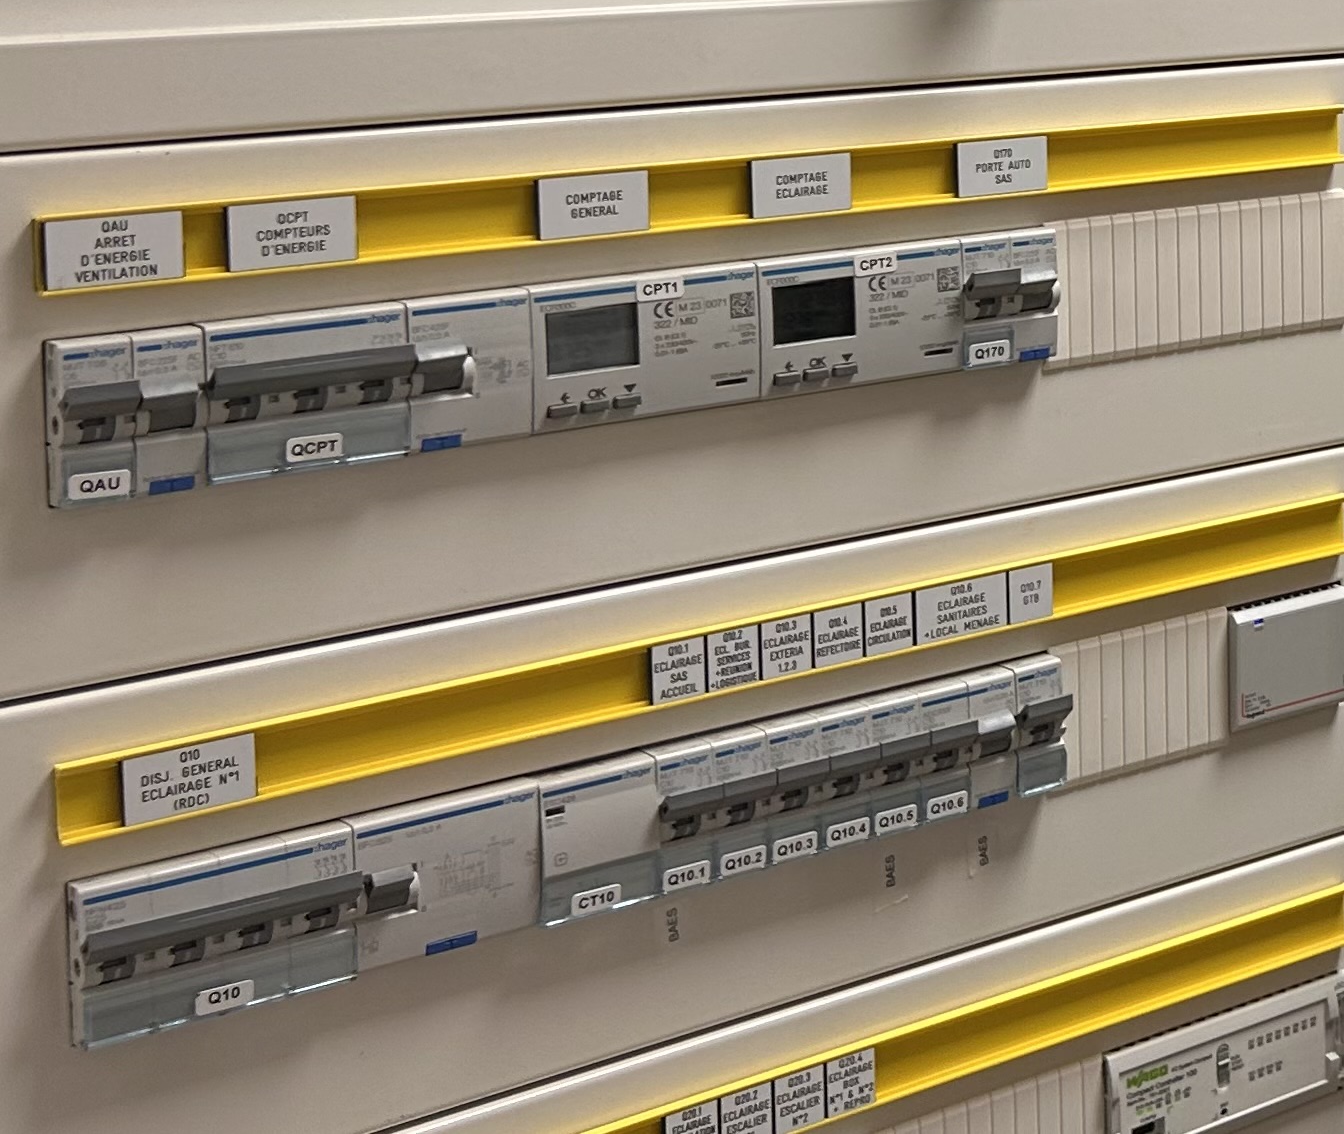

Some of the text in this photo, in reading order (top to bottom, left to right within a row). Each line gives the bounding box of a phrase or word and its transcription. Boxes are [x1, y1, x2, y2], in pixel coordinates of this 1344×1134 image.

[975, 159, 1031, 173] PORTE AUTO
[775, 171, 828, 186] COMPTAGE
[995, 173, 1013, 184] SAS
[565, 190, 623, 206] COMPTAGE
[775, 184, 829, 200] ECLAIRAGE
[570, 204, 619, 219] GENERAL
[101, 219, 129, 233] QAU
[255, 224, 331, 242] COMPTEURS
[94, 234, 137, 250] ARRET
[260, 240, 327, 257] D'ENERGIE
[80, 249, 151, 267] D'ENERGIE
[859, 256, 893, 272] CPT2
[74, 264, 159, 283] VENTILATION
[642, 282, 678, 296] CPT1
[689, 301, 702, 311] 23
[654, 319, 672, 330] 322
[974, 345, 1005, 360] Q170
[587, 386, 607, 400] OK
[290, 439, 338, 456] QCPT
[80, 477, 120, 493] QAU
[950, 582, 973, 596] Q10.6
[937, 592, 986, 612] ECLAIRAGE
[936, 604, 988, 625] SANITAIRES
[963, 614, 1000, 631] MENAGE
[775, 620, 797, 634] Q10.3
[869, 615, 908, 633] ECLAIRAGE
[763, 630, 810, 650] ECLAIRAGE
[817, 626, 860, 645] ECLAIRAGE
[867, 627, 912, 647] CIRCULATION
[667, 643, 689, 657] Q10.1
[816, 639, 862, 658] REFECTOIRE
[654, 654, 703, 674] ECLAIRAGE
[716, 651, 751, 667] SERVICES
[670, 671, 688, 684] SAS
[660, 683, 698, 700] ACCUEIL
[181, 756, 240, 778] GENERAL
[141, 770, 240, 803] ECLAIRAGE N°1
[173, 792, 210, 811] (RDC)
[930, 796, 964, 814] Q10.6
[879, 810, 914, 828] Q10.5
[830, 823, 866, 842] Q10.4
[777, 838, 814, 856] Q10.3
[978, 835, 989, 866] BAES
[725, 852, 763, 870] Q10.2
[668, 866, 705, 885] Q10.1
[885, 854, 896, 888] BAES
[577, 890, 615, 910] CT10
[666, 907, 680, 942] BAES
[208, 986, 241, 1005] Q10
[829, 1060, 873, 1083] ECLAIRAGE
[842, 1076, 860, 1090] BOX
[776, 1081, 823, 1106] ECLAIRAGE
[844, 1094, 871, 1111] REPRO
[723, 1099, 770, 1124] ECLAIRAGE
[779, 1095, 821, 1118] ESCALIER
[726, 1113, 768, 1134] ESCALIER
